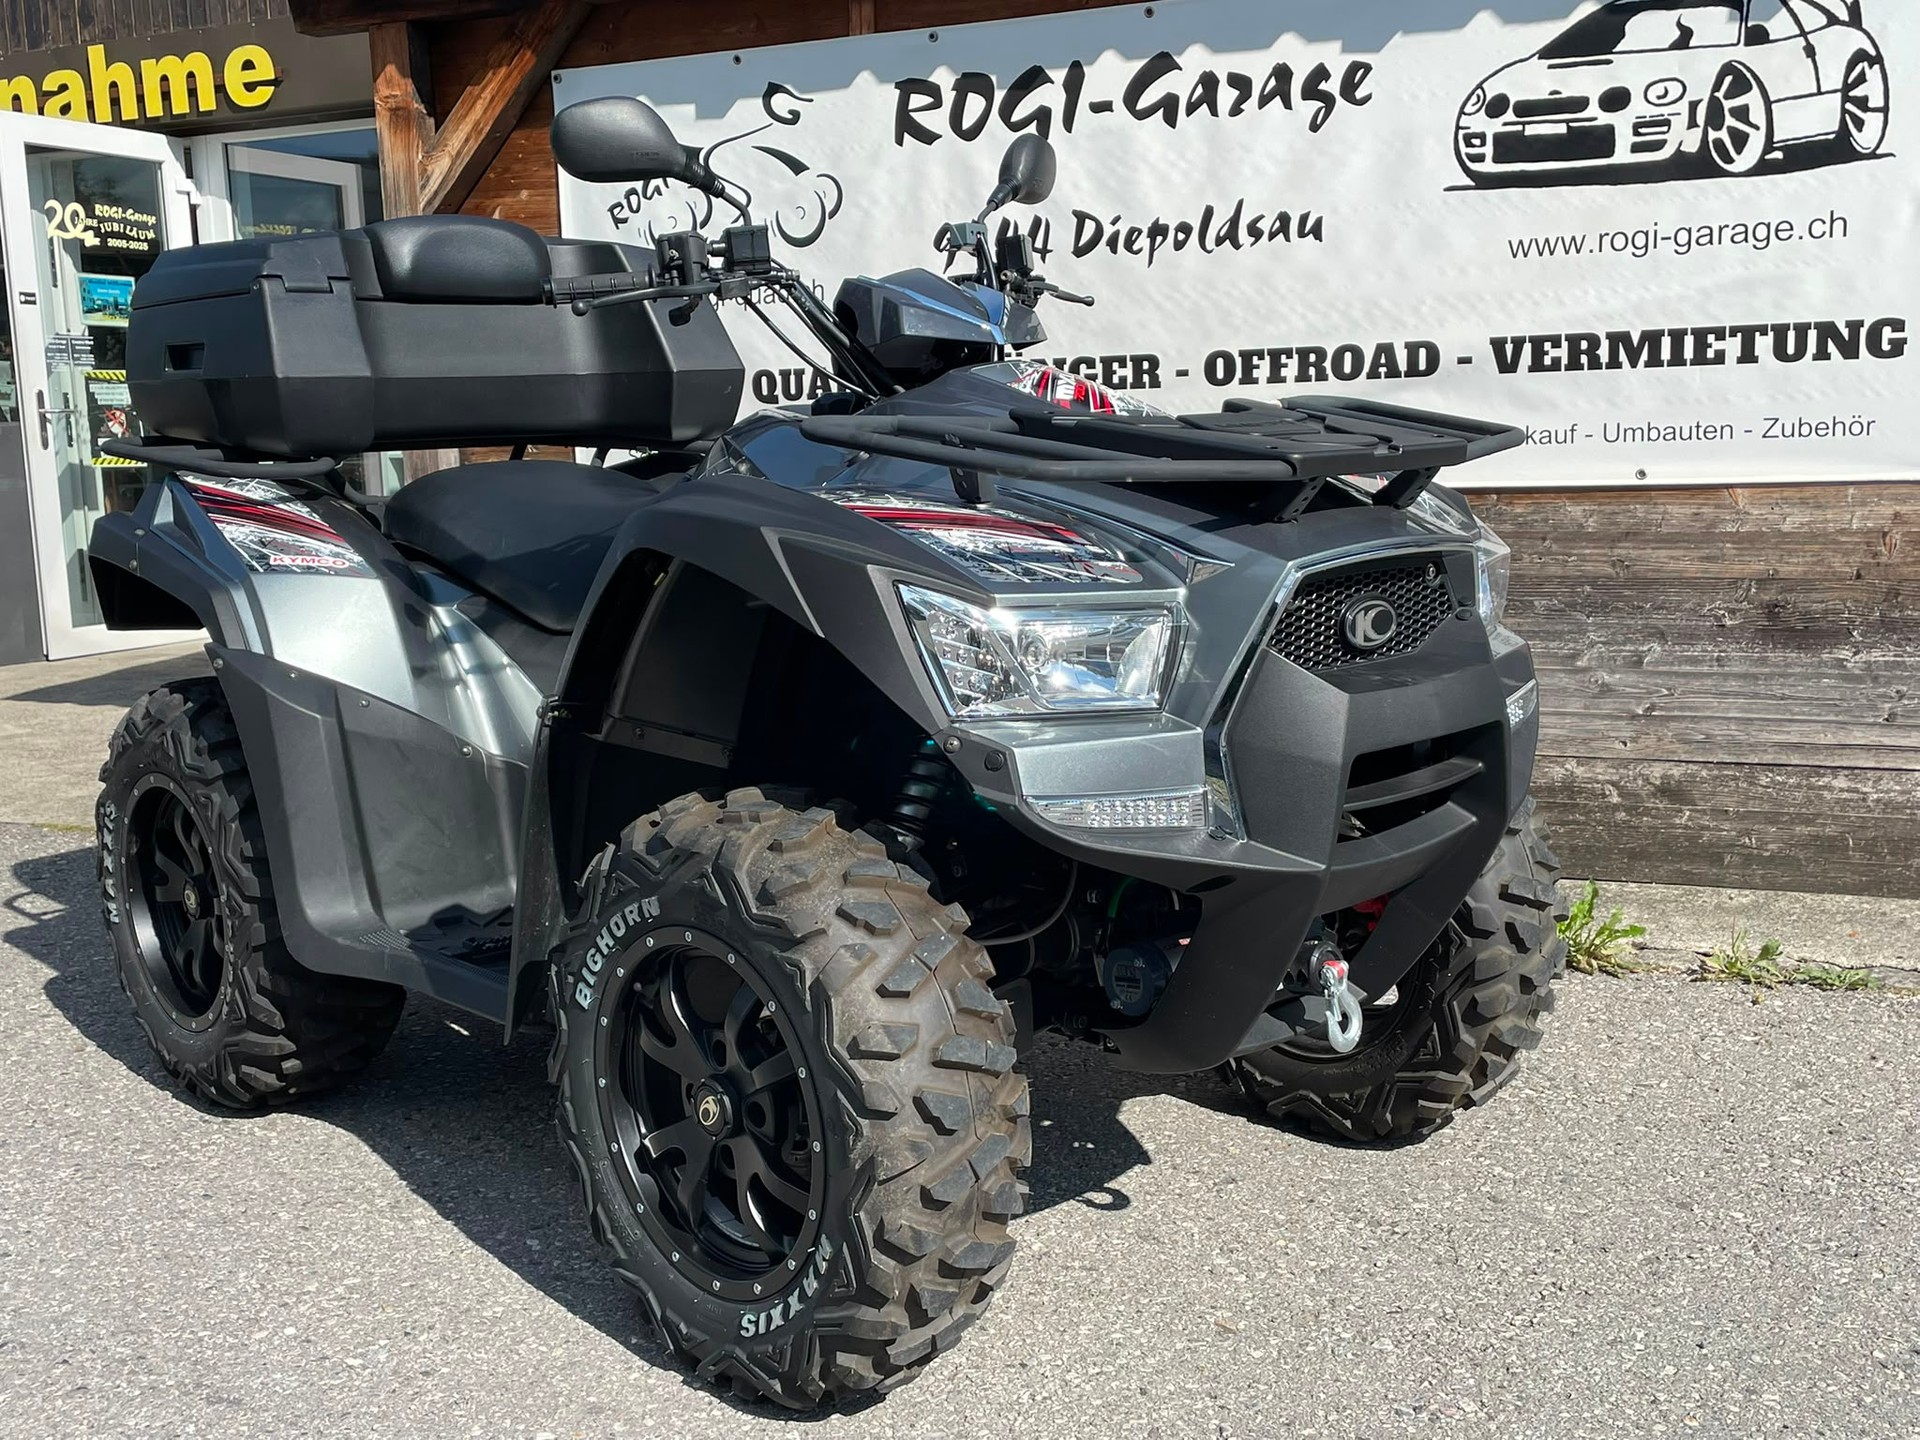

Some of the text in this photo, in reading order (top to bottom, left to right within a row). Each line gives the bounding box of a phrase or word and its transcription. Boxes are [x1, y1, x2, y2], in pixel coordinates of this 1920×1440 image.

[0, 44, 275, 123] nahme
[895, 51, 1373, 147] ROGI-Garage
[1072, 199, 1324, 268] Diepoldsau
[1508, 210, 1849, 258] www.rogi-garage.ch
[752, 367, 847, 405] QUA
[1204, 340, 1441, 386] OFFROAD
[1489, 317, 1908, 374] VERMIETUNG
[1602, 420, 1734, 444] Umbauten
[1761, 415, 1877, 439] Zubehör
[272, 556, 347, 567] KYMCO
[102, 800, 120, 924] MAXXIS
[575, 896, 661, 1010] BIGHORN
[740, 1233, 833, 1337] MAXXIS
